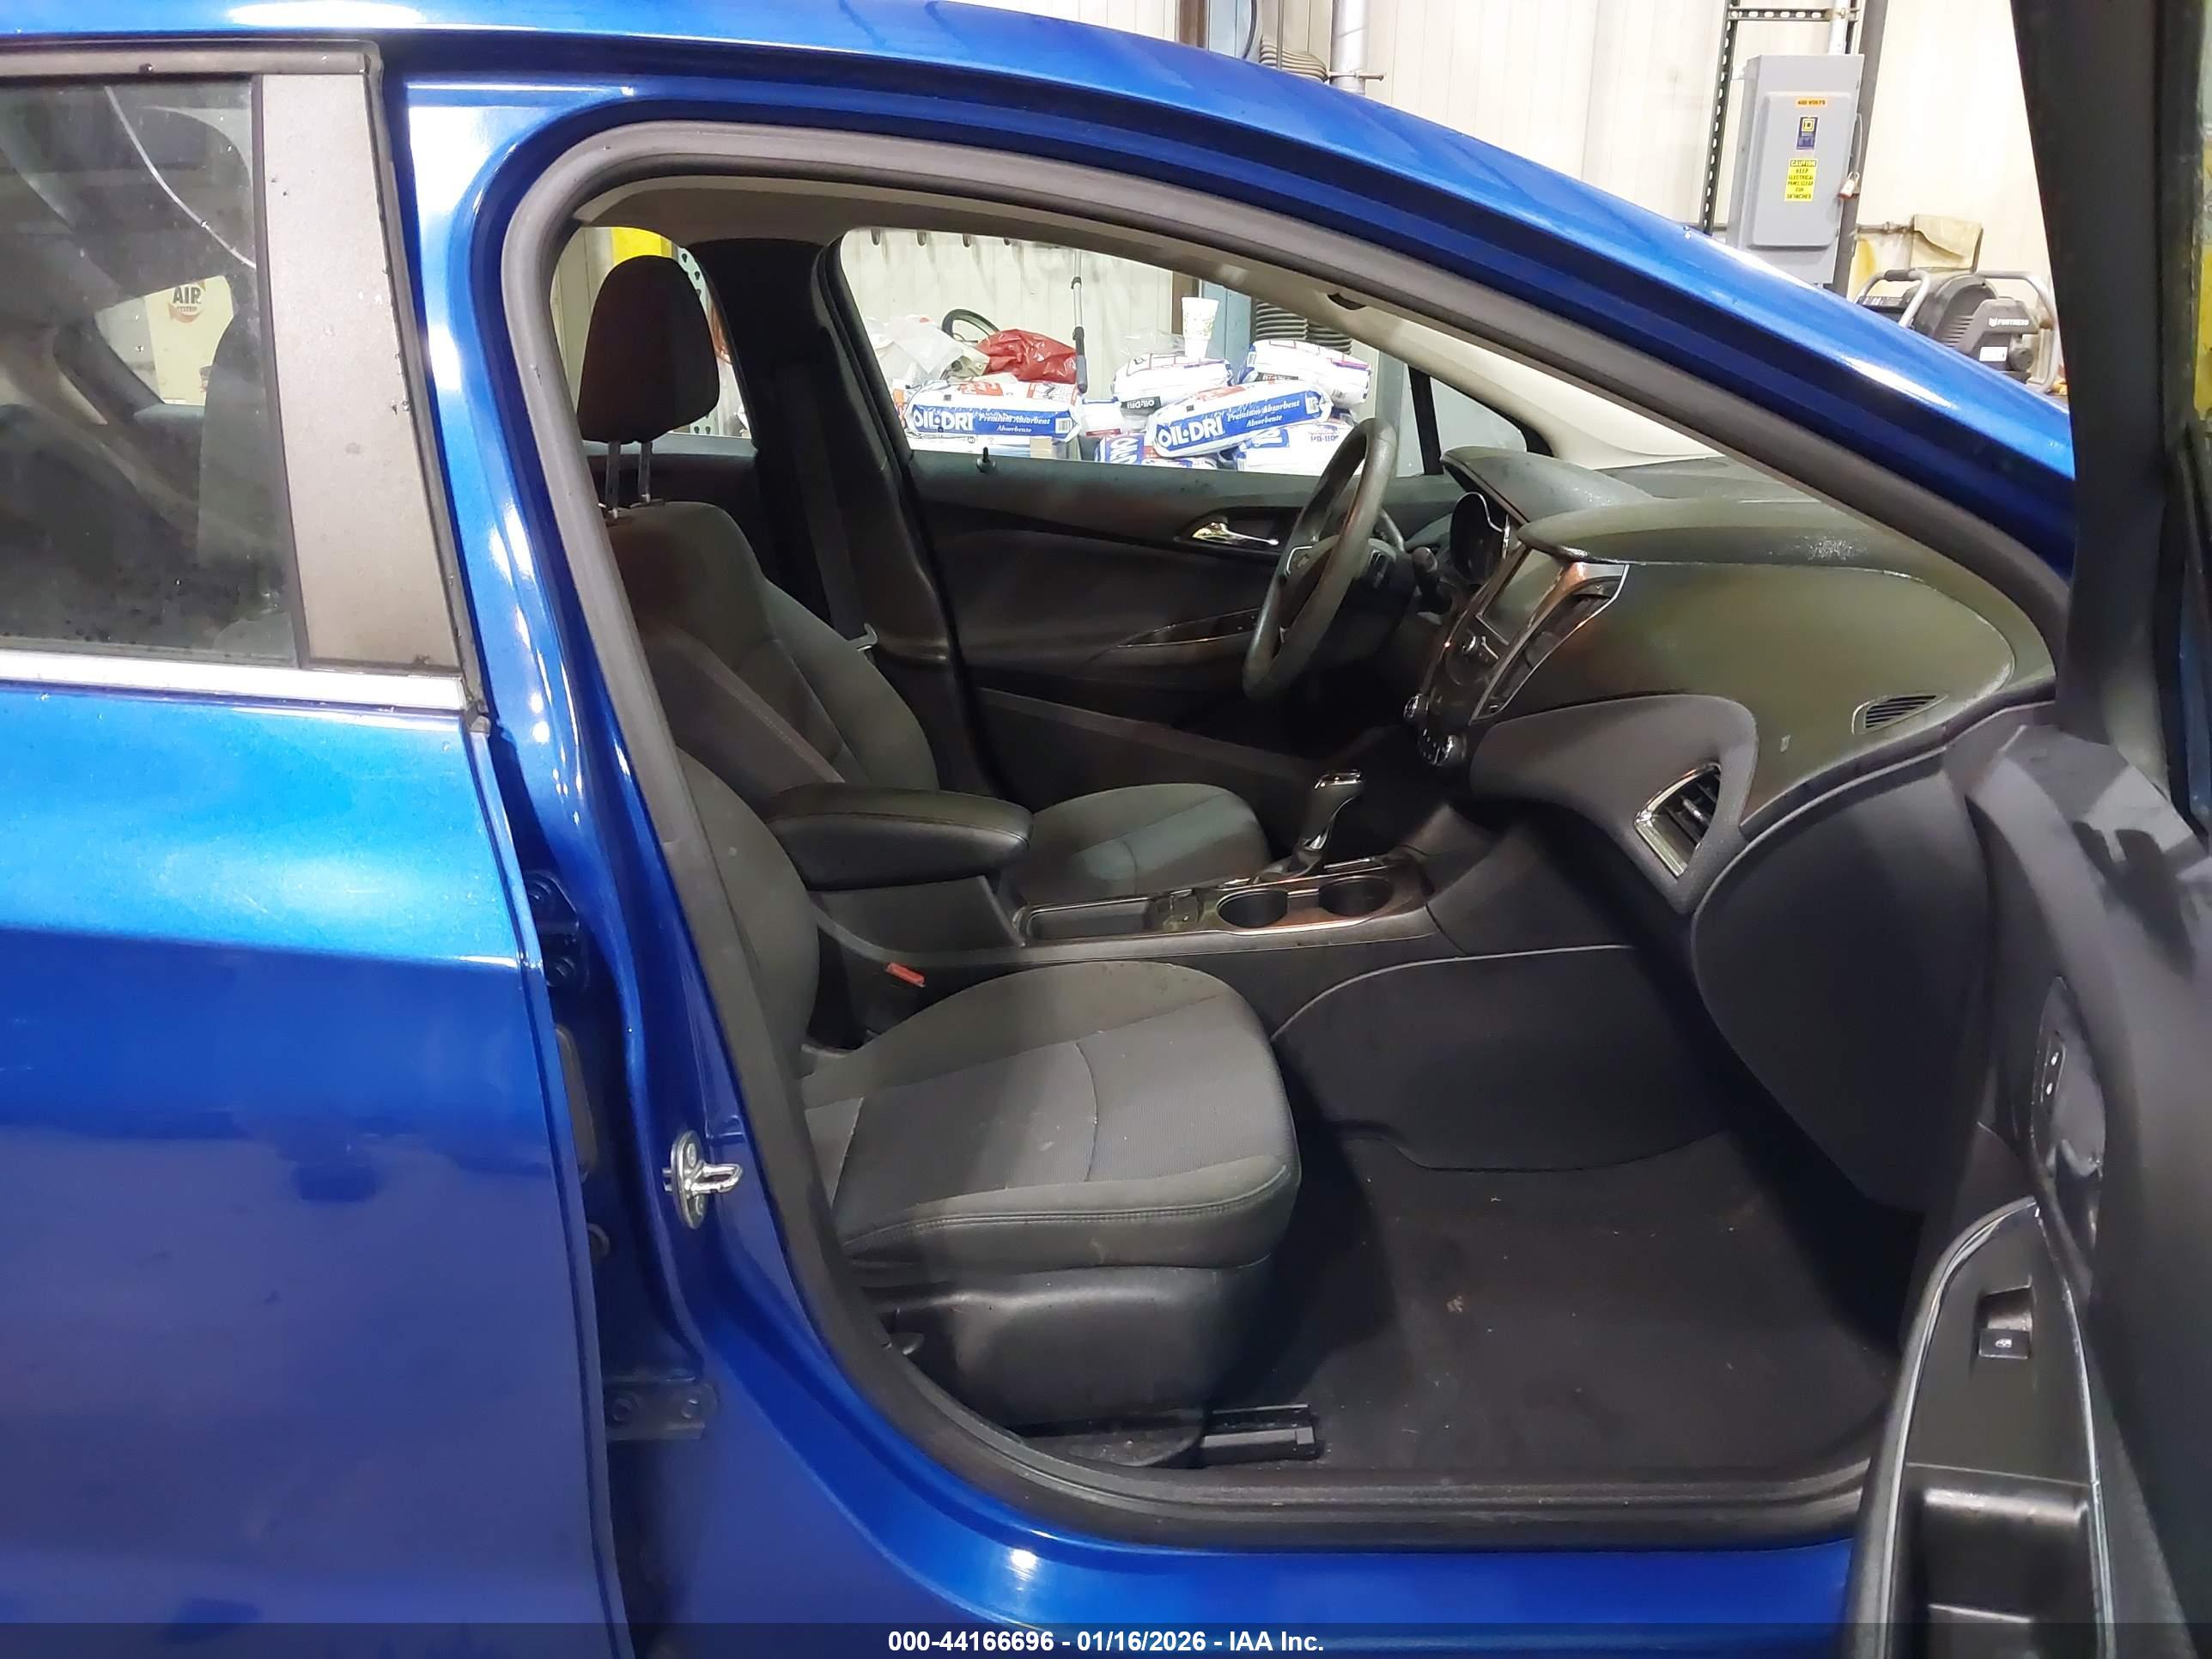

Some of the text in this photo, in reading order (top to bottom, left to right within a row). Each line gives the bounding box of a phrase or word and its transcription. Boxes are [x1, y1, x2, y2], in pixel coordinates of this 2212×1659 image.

[173, 287, 201, 304] AIR
[1261, 399, 1301, 415] Absorbent
[1012, 415, 1051, 426] Absorbent
[1247, 415, 1283, 428] Absorbente
